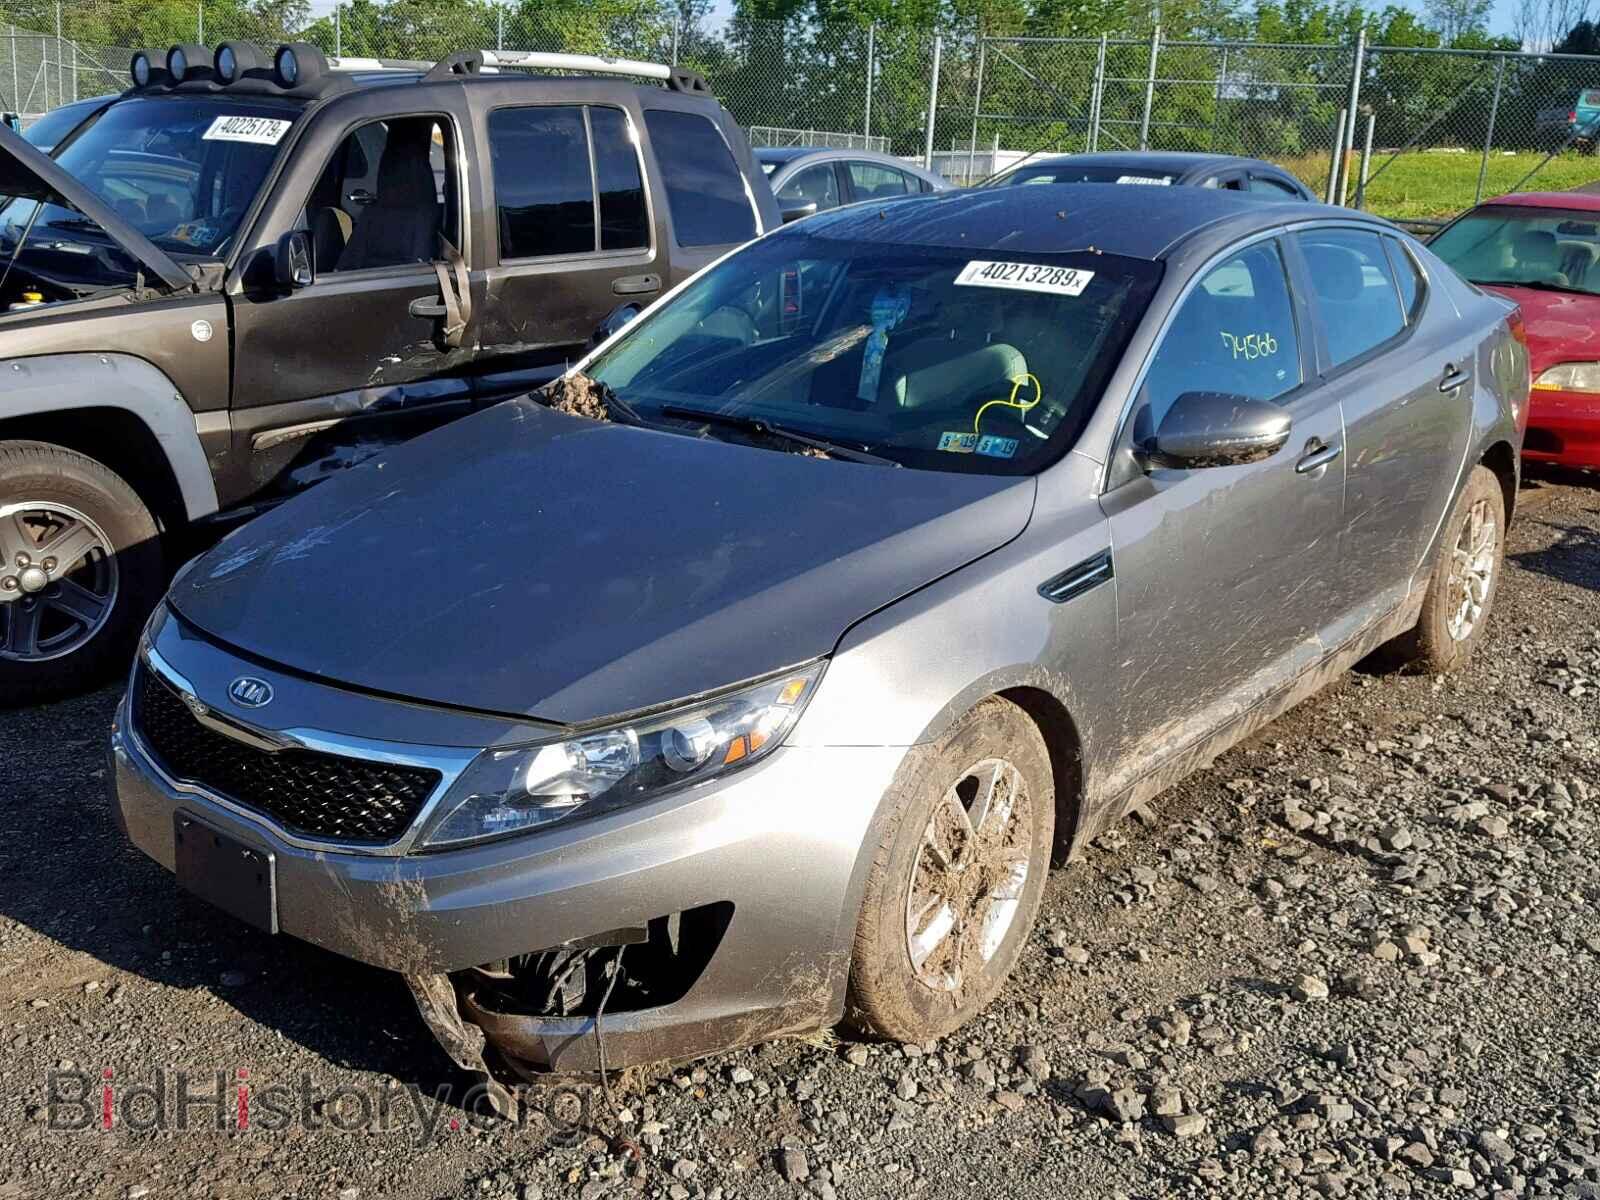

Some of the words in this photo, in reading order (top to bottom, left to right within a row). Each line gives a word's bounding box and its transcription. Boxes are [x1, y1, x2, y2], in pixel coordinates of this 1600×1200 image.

[1219, 330, 1278, 361] 74566
[981, 440, 991, 452] 5
[1004, 440, 1017, 454] 19
[233, 680, 268, 703] KIA
